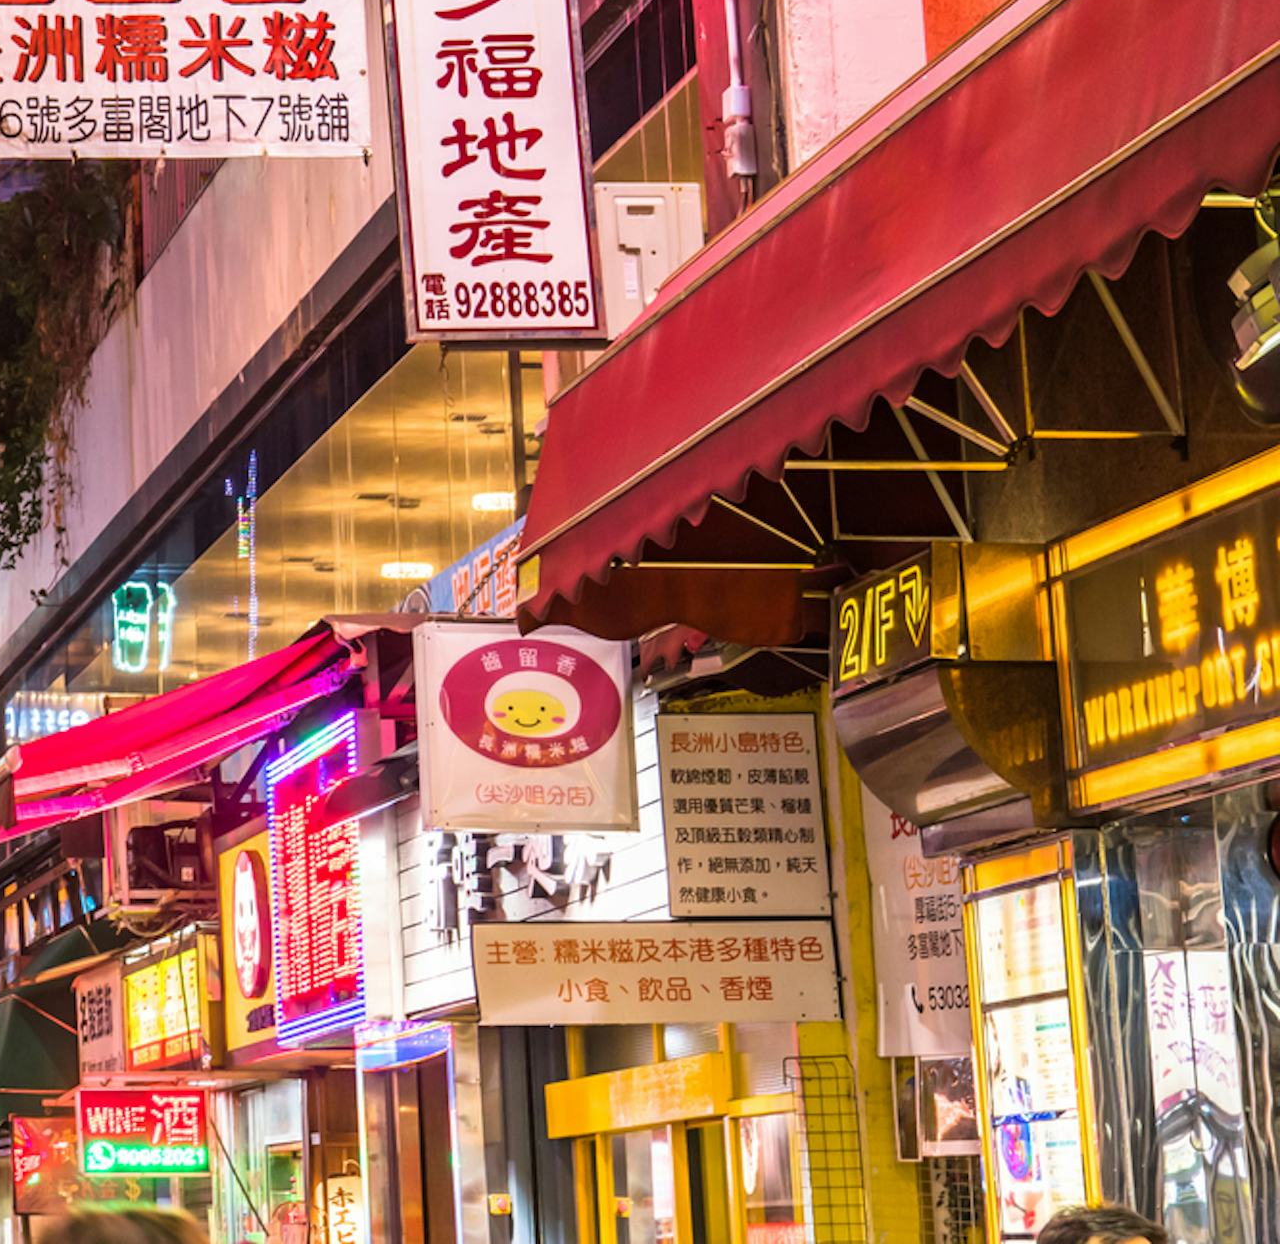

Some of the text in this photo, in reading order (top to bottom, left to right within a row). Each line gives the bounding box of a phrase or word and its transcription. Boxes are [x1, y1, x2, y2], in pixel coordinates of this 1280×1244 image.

[421, 272, 591, 324] 電話 92888385
[839, 578, 895, 682] 2/F
[480, 646, 577, 678] 齒留香
[86, 1094, 201, 1146] WINE 酒
